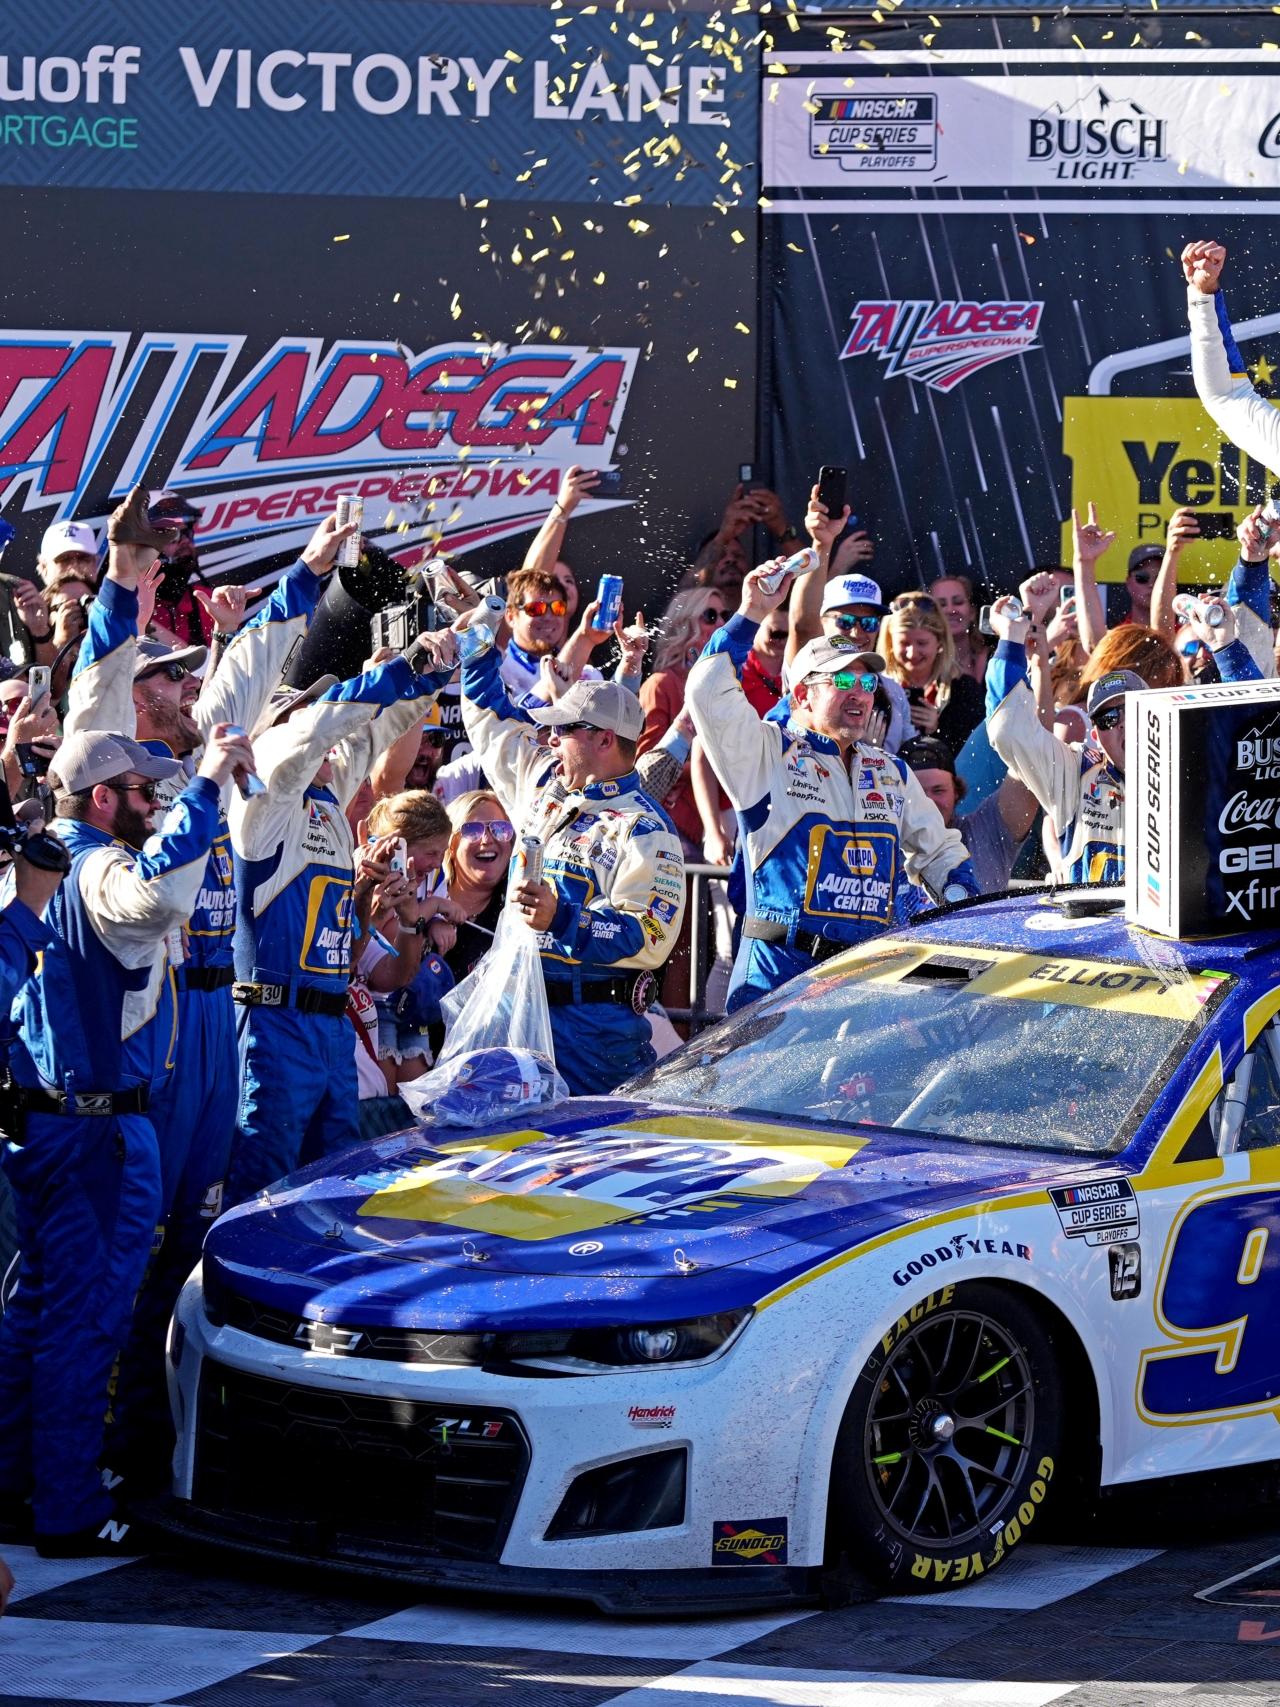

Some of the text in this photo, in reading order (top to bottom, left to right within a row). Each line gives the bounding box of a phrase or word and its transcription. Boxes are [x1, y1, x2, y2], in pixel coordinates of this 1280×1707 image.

[179, 47, 728, 126] VICTORY LANE
[849, 100, 918, 119] NASCAR
[0, 114, 138, 148] RTGAGE
[829, 127, 918, 143] CUP SERIES
[1029, 118, 1168, 162] BUSCH
[860, 156, 916, 167] PLAYOFFS
[1056, 161, 1133, 179] LIGHT
[846, 300, 1043, 362] TALLADEGA
[907, 335, 1030, 361] SUPERSPEEDWAY
[193, 466, 562, 536] UPERSPEEDWA
[1200, 686, 1251, 700] CUP
[1148, 709, 1161, 873] CUP SERIES
[847, 849, 873, 866] NAPA
[654, 876, 682, 890] SIEMEN
[651, 886, 680, 902] Acron
[834, 895, 880, 912] CENTER
[1028, 963, 1178, 995] ELLIOTT
[1078, 1183, 1121, 1203] NASCAR
[1071, 1204, 1127, 1225] CUP SERIES
[1096, 1228, 1129, 1242] PLAYOFFS
[1114, 1251, 1140, 1293] 12
[881, 1283, 957, 1356] EAGLE
[628, 1405, 677, 1422] Hendrick
[428, 1416, 504, 1438] ZL1
[717, 1535, 784, 1551] SUNOCO
